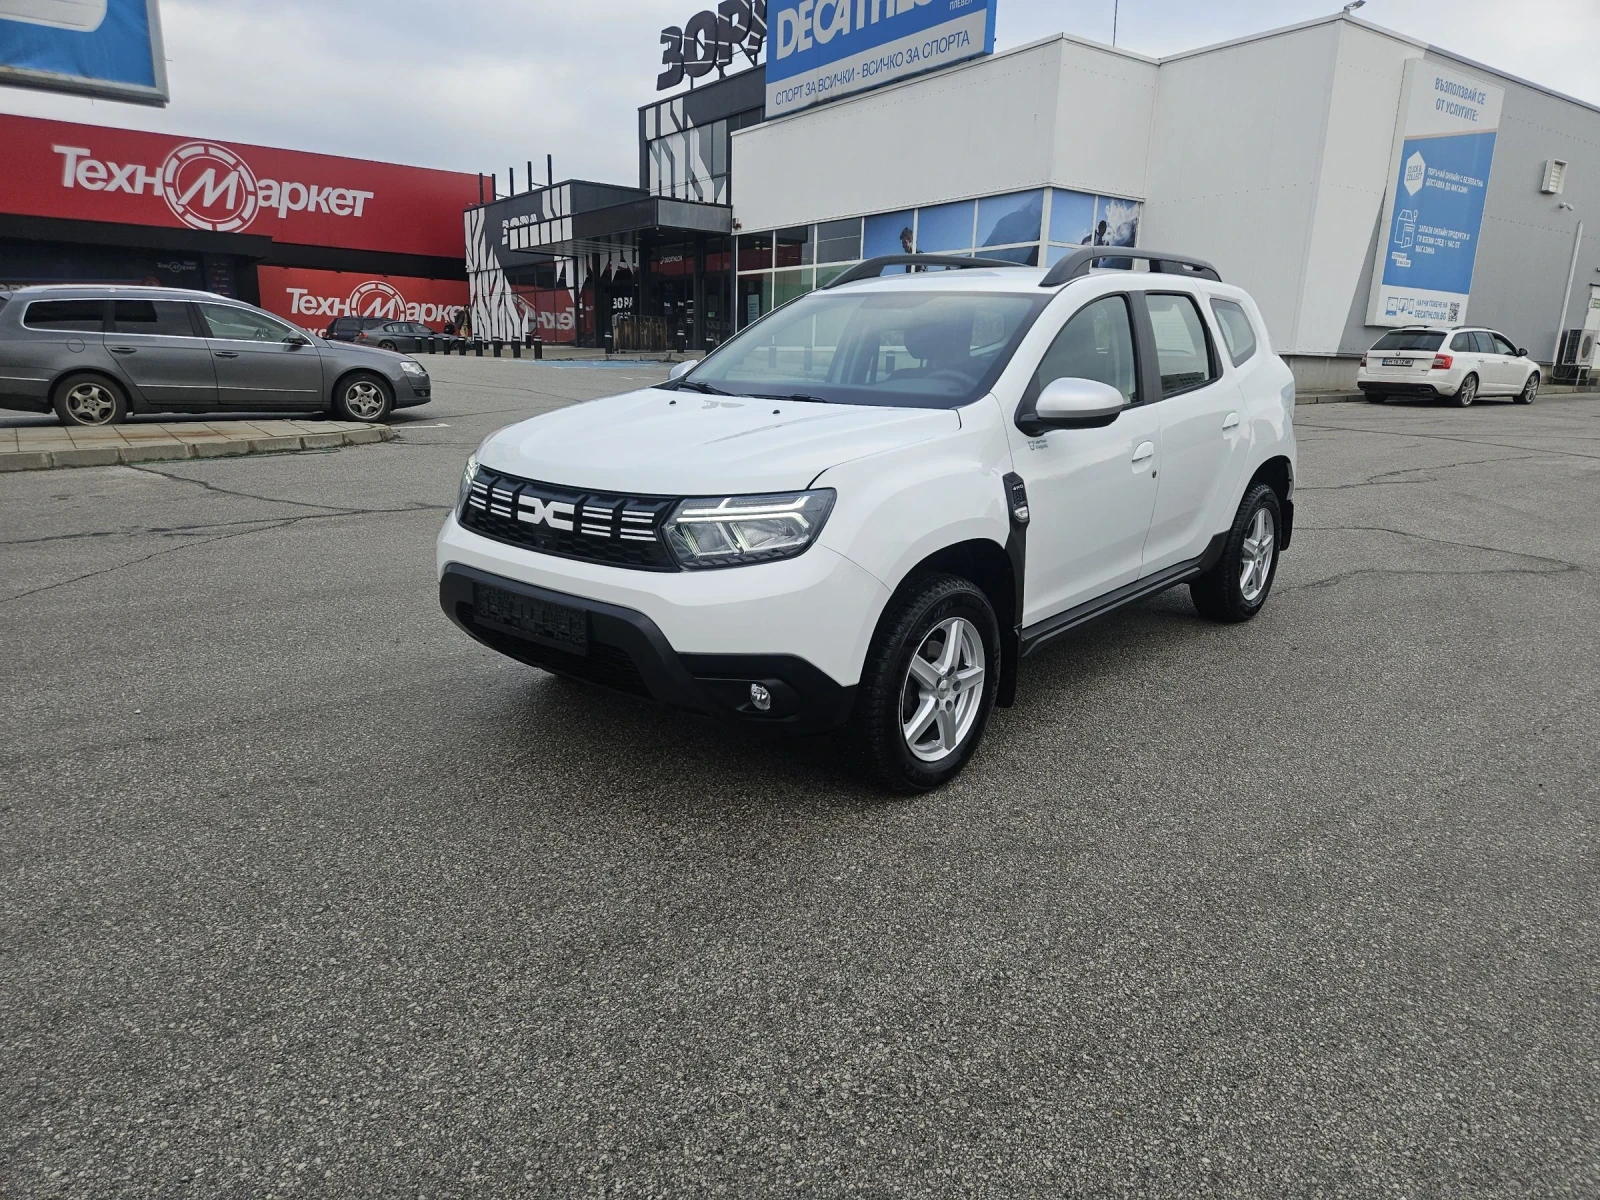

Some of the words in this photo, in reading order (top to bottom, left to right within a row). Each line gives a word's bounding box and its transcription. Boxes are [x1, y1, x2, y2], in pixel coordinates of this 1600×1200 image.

[775, 85, 803, 106] СПОРТ
[805, 81, 817, 97] ЗА
[818, 68, 855, 93] ВСИЧКИ
[862, 51, 903, 78] ВСИЧКО
[906, 46, 920, 65] ЗА
[922, 29, 970, 58] СПОРТА
[1435, 77, 1477, 102] ВЪЗПОЛЗВАЙ
[1477, 91, 1486, 105] СЕ
[1436, 98, 1446, 112] ОТ
[1445, 101, 1478, 122] УСЛУГИТЕ:
[1406, 172, 1423, 182] COLLECT
